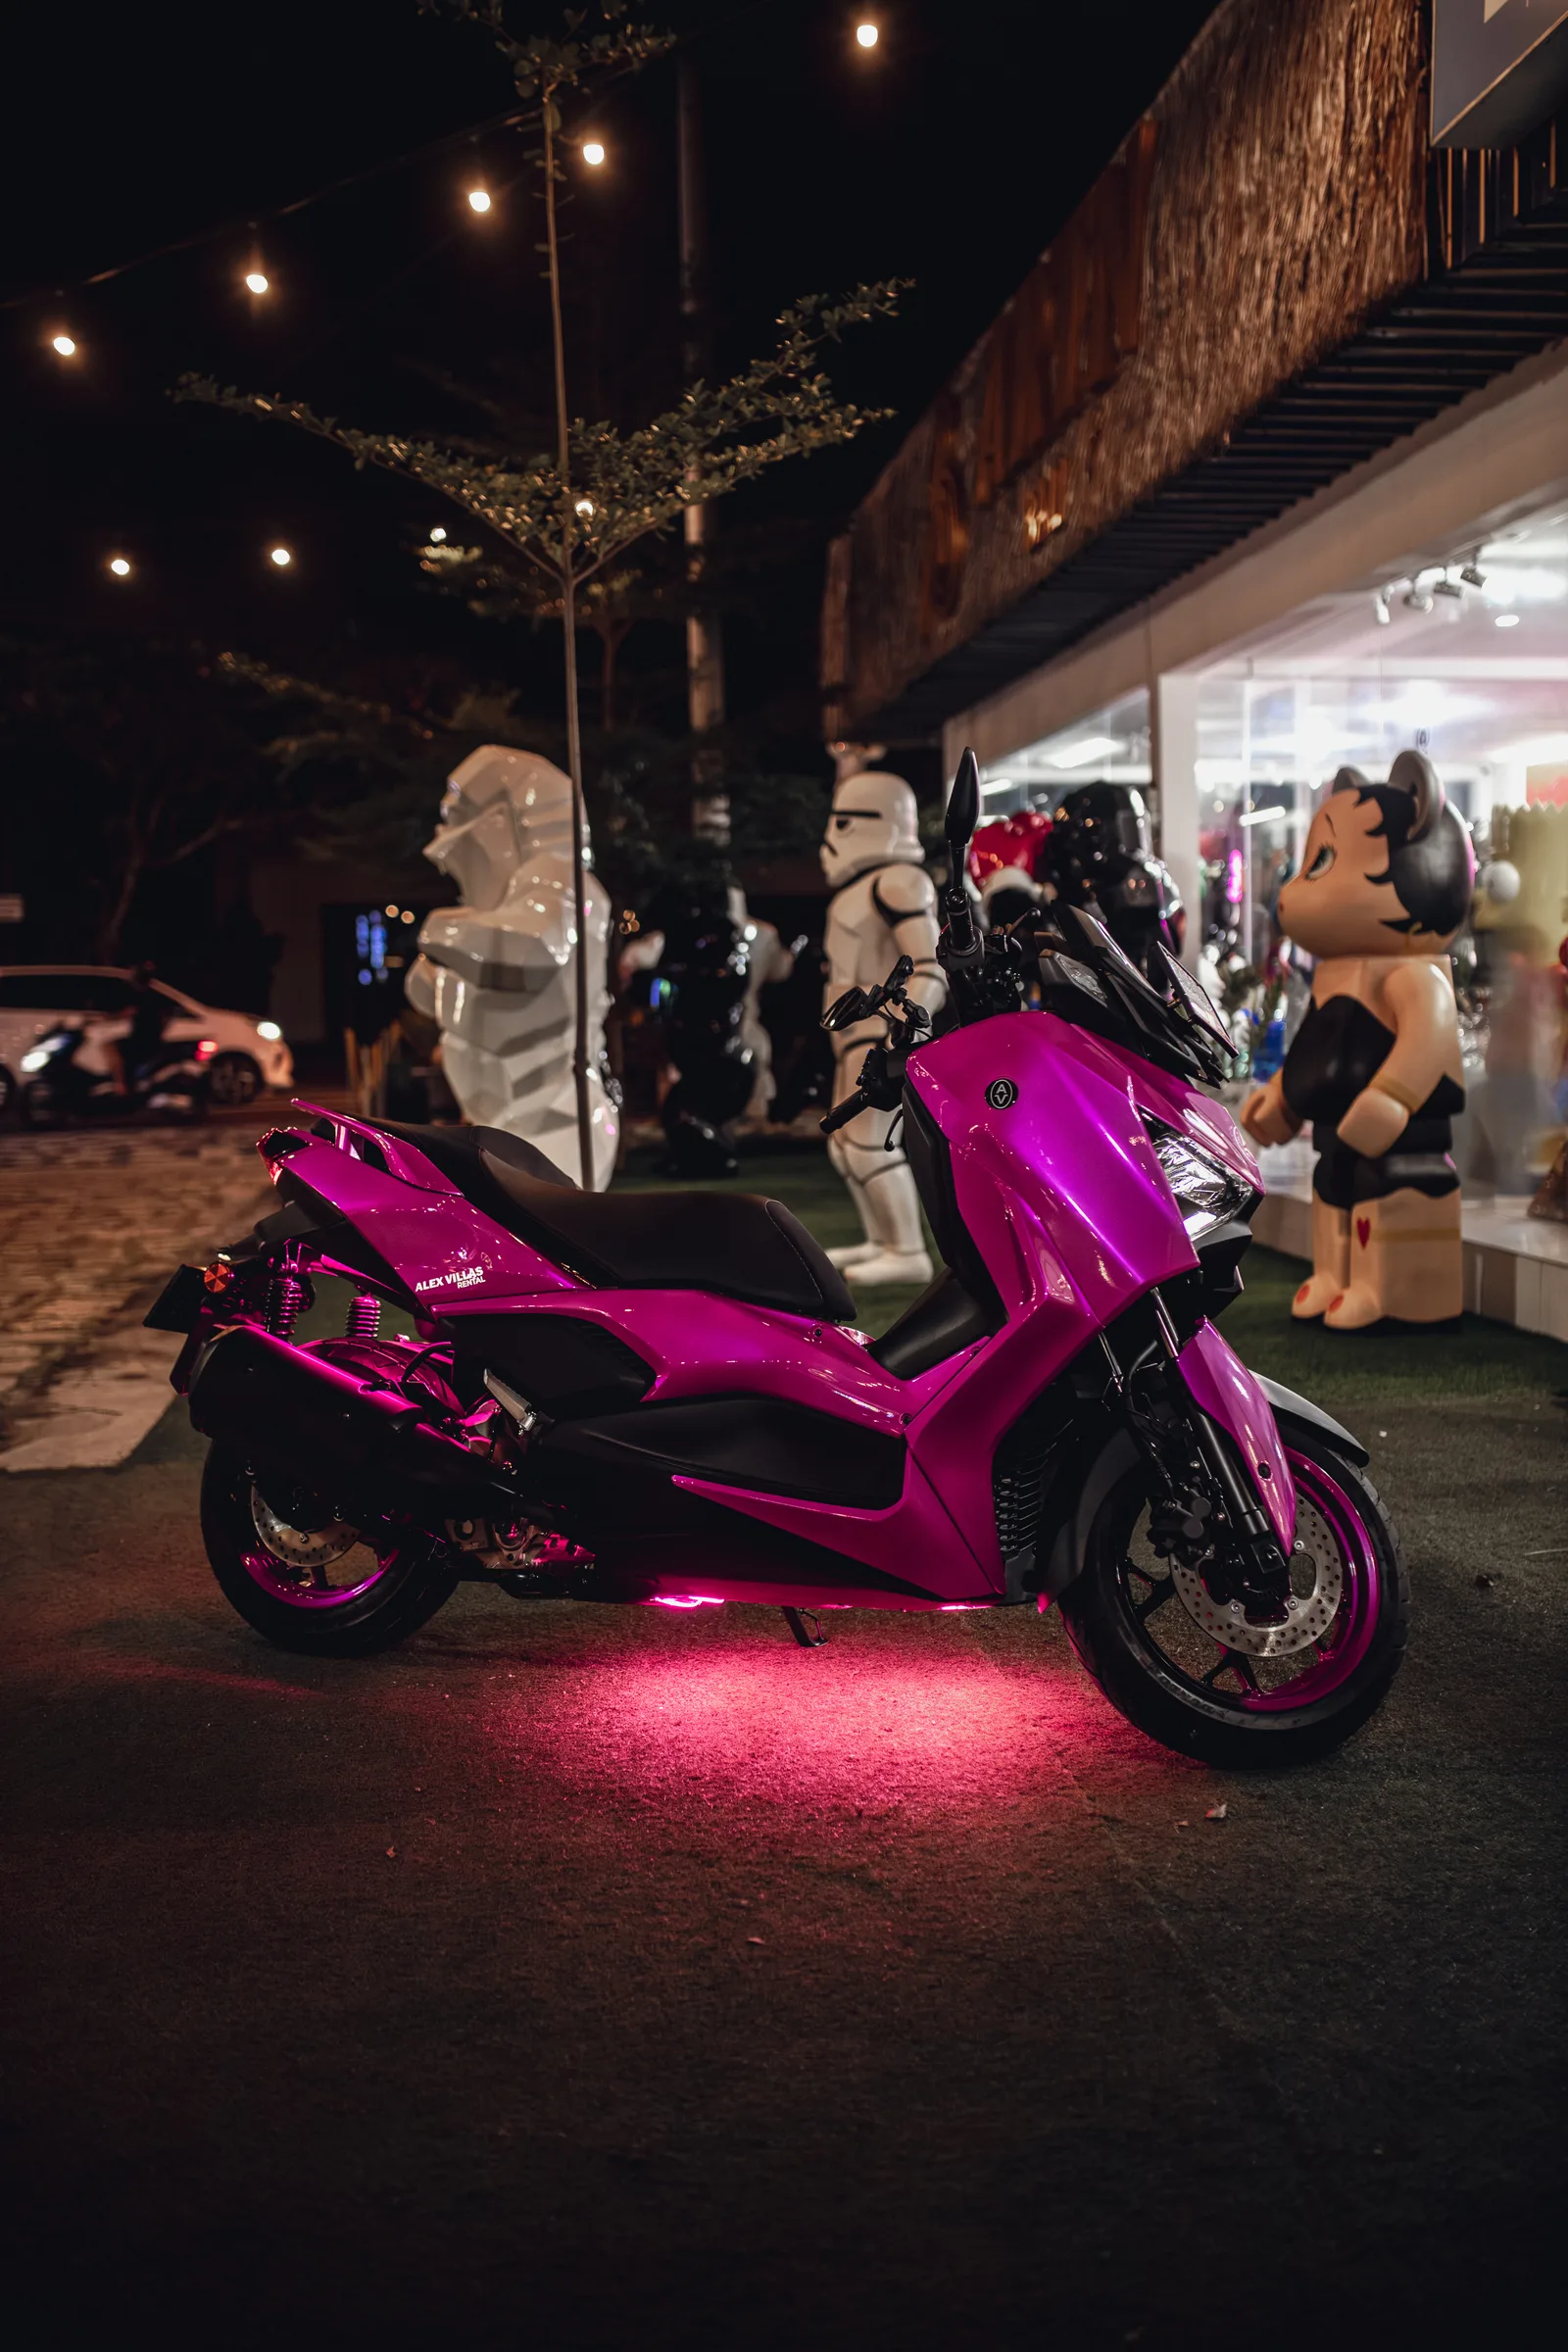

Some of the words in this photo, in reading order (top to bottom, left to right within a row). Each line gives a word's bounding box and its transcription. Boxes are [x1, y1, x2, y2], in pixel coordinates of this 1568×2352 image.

[416, 1277, 444, 1293] ALEX
[444, 1266, 484, 1285] VILLAS
[457, 1276, 486, 1290] RENTAL
